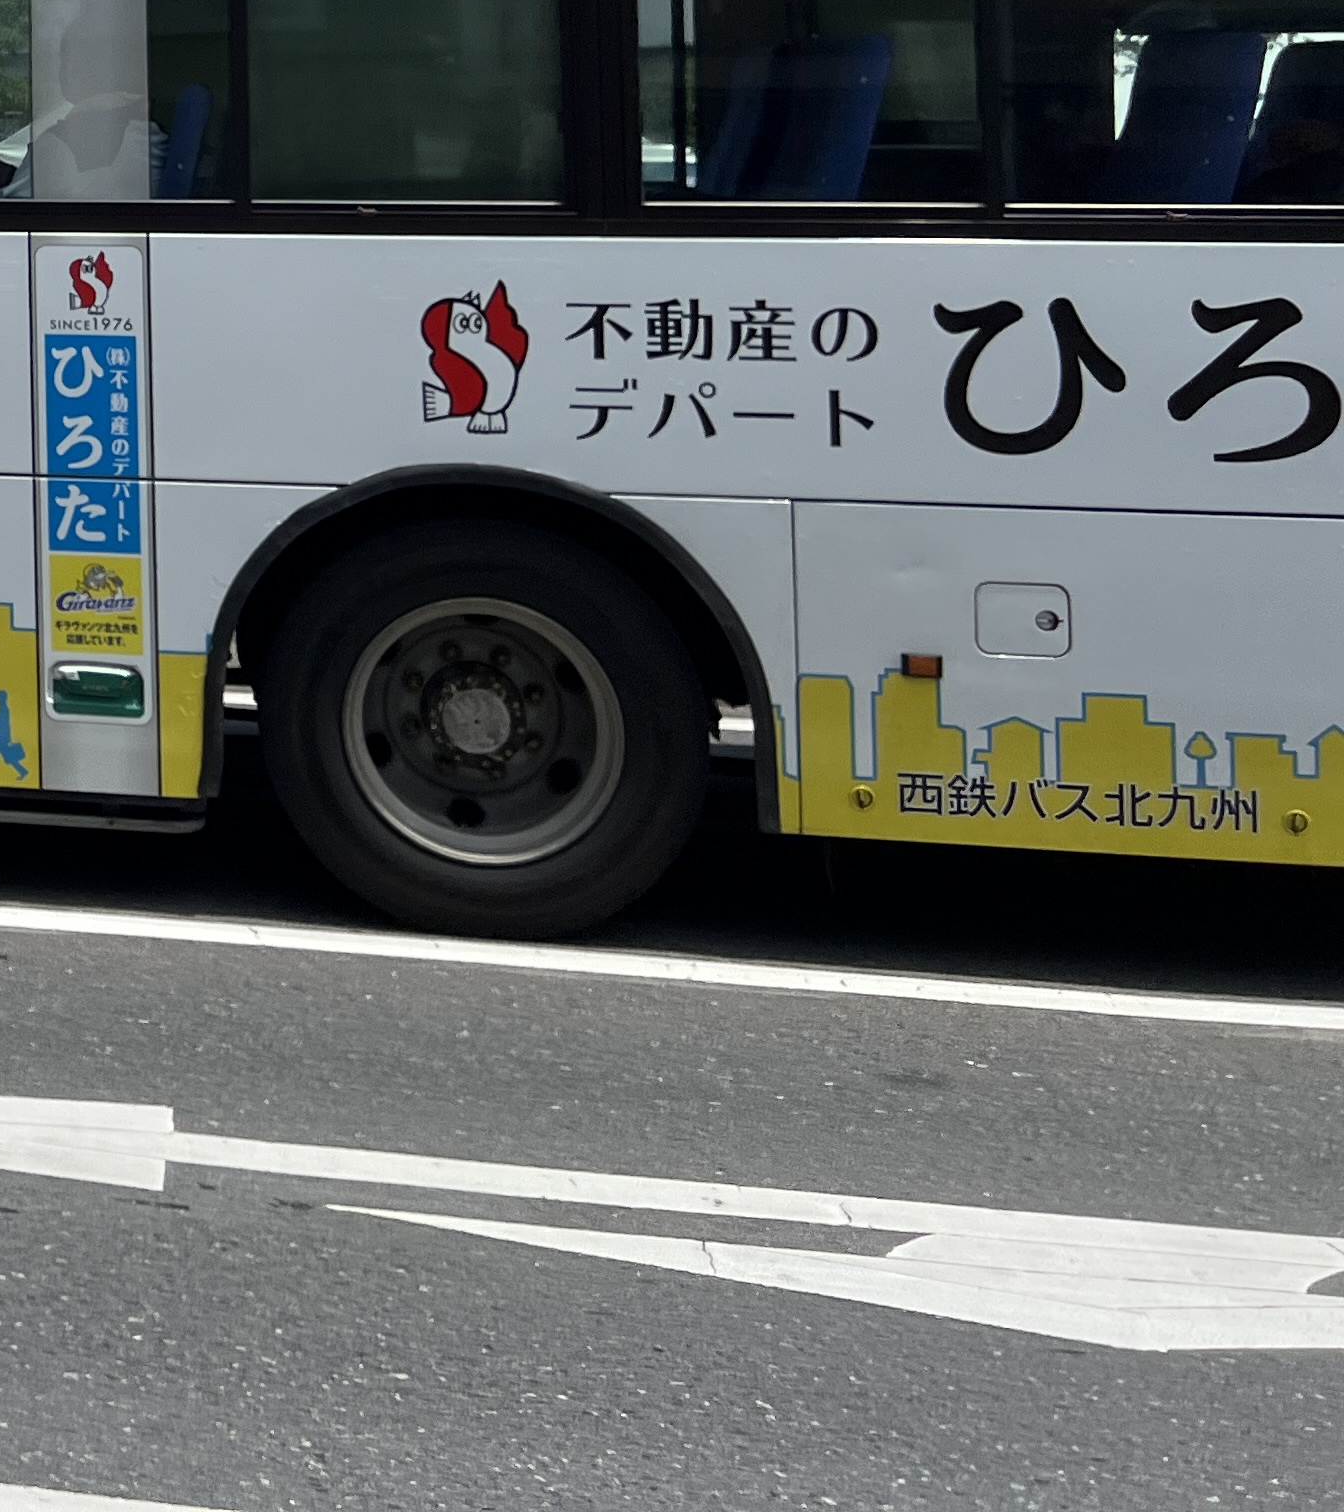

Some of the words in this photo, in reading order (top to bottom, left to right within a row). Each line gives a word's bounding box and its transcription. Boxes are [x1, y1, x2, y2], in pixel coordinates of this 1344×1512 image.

[564, 299, 880, 364] 不動産の
[568, 377, 876, 449] デパート
[932, 297, 1342, 464] ひろ
[50, 345, 107, 543] ひろた
[896, 772, 1259, 834] 西鉄バス北九州
